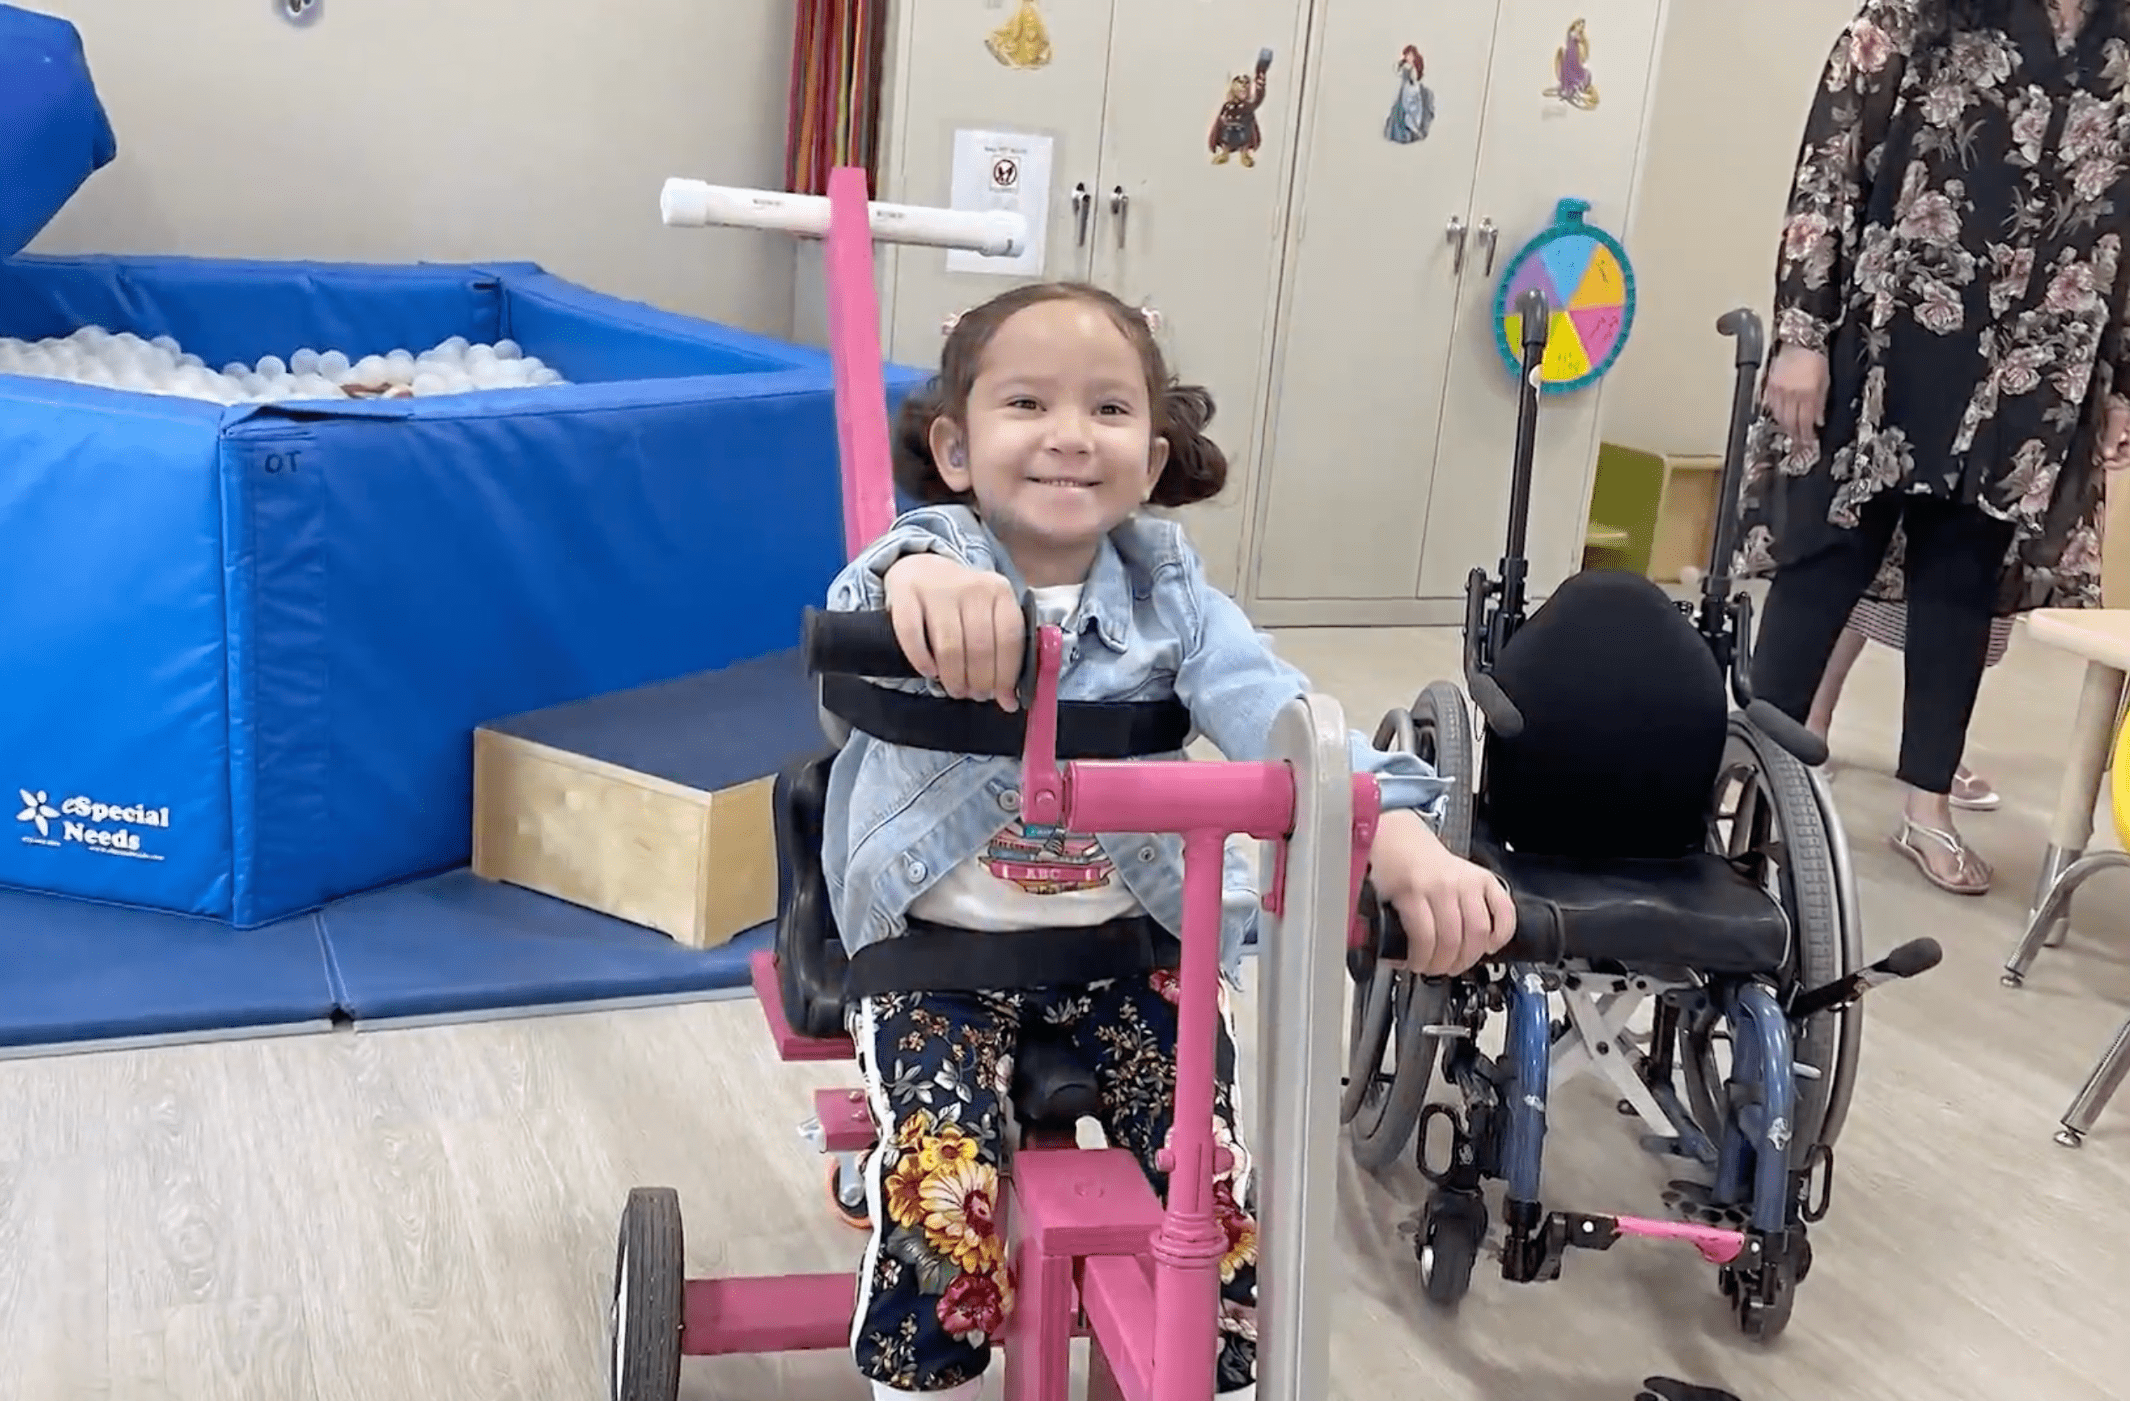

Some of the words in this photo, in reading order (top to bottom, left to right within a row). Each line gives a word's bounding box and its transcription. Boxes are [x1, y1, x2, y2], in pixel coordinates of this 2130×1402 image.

[264, 450, 301, 474] OT
[61, 796, 169, 828] eSpecial
[63, 820, 140, 850] Needs
